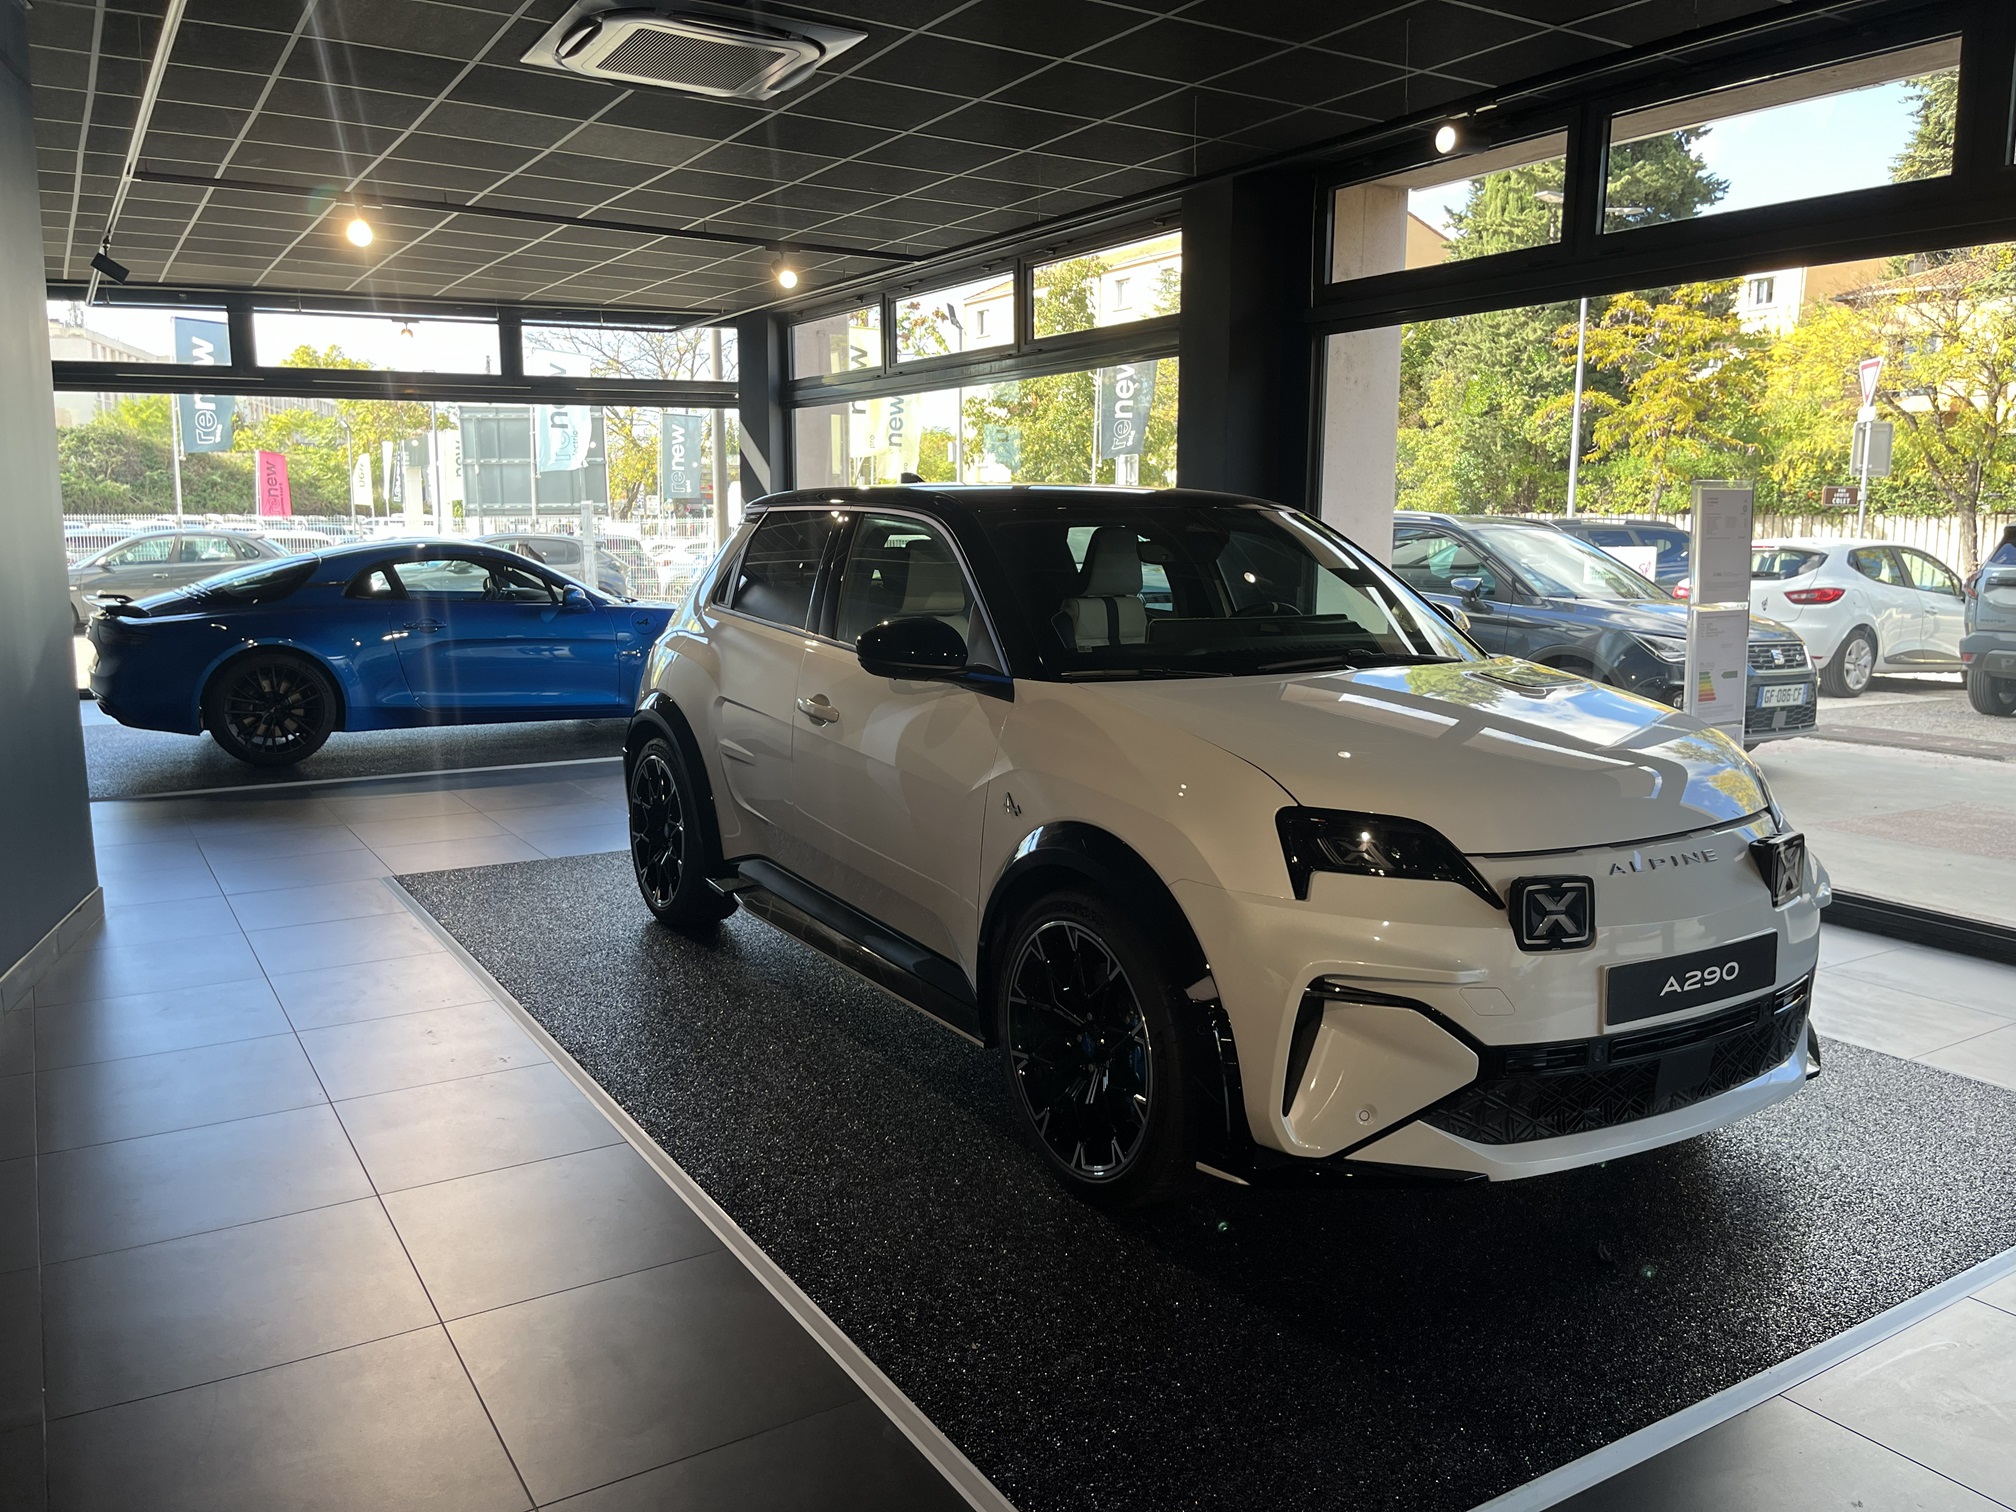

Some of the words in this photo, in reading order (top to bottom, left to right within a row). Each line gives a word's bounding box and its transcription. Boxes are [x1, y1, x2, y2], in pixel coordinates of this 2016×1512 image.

[671, 423, 685, 493] renew
[1609, 848, 1719, 876] ALPINE
[1659, 961, 1740, 997] A290
